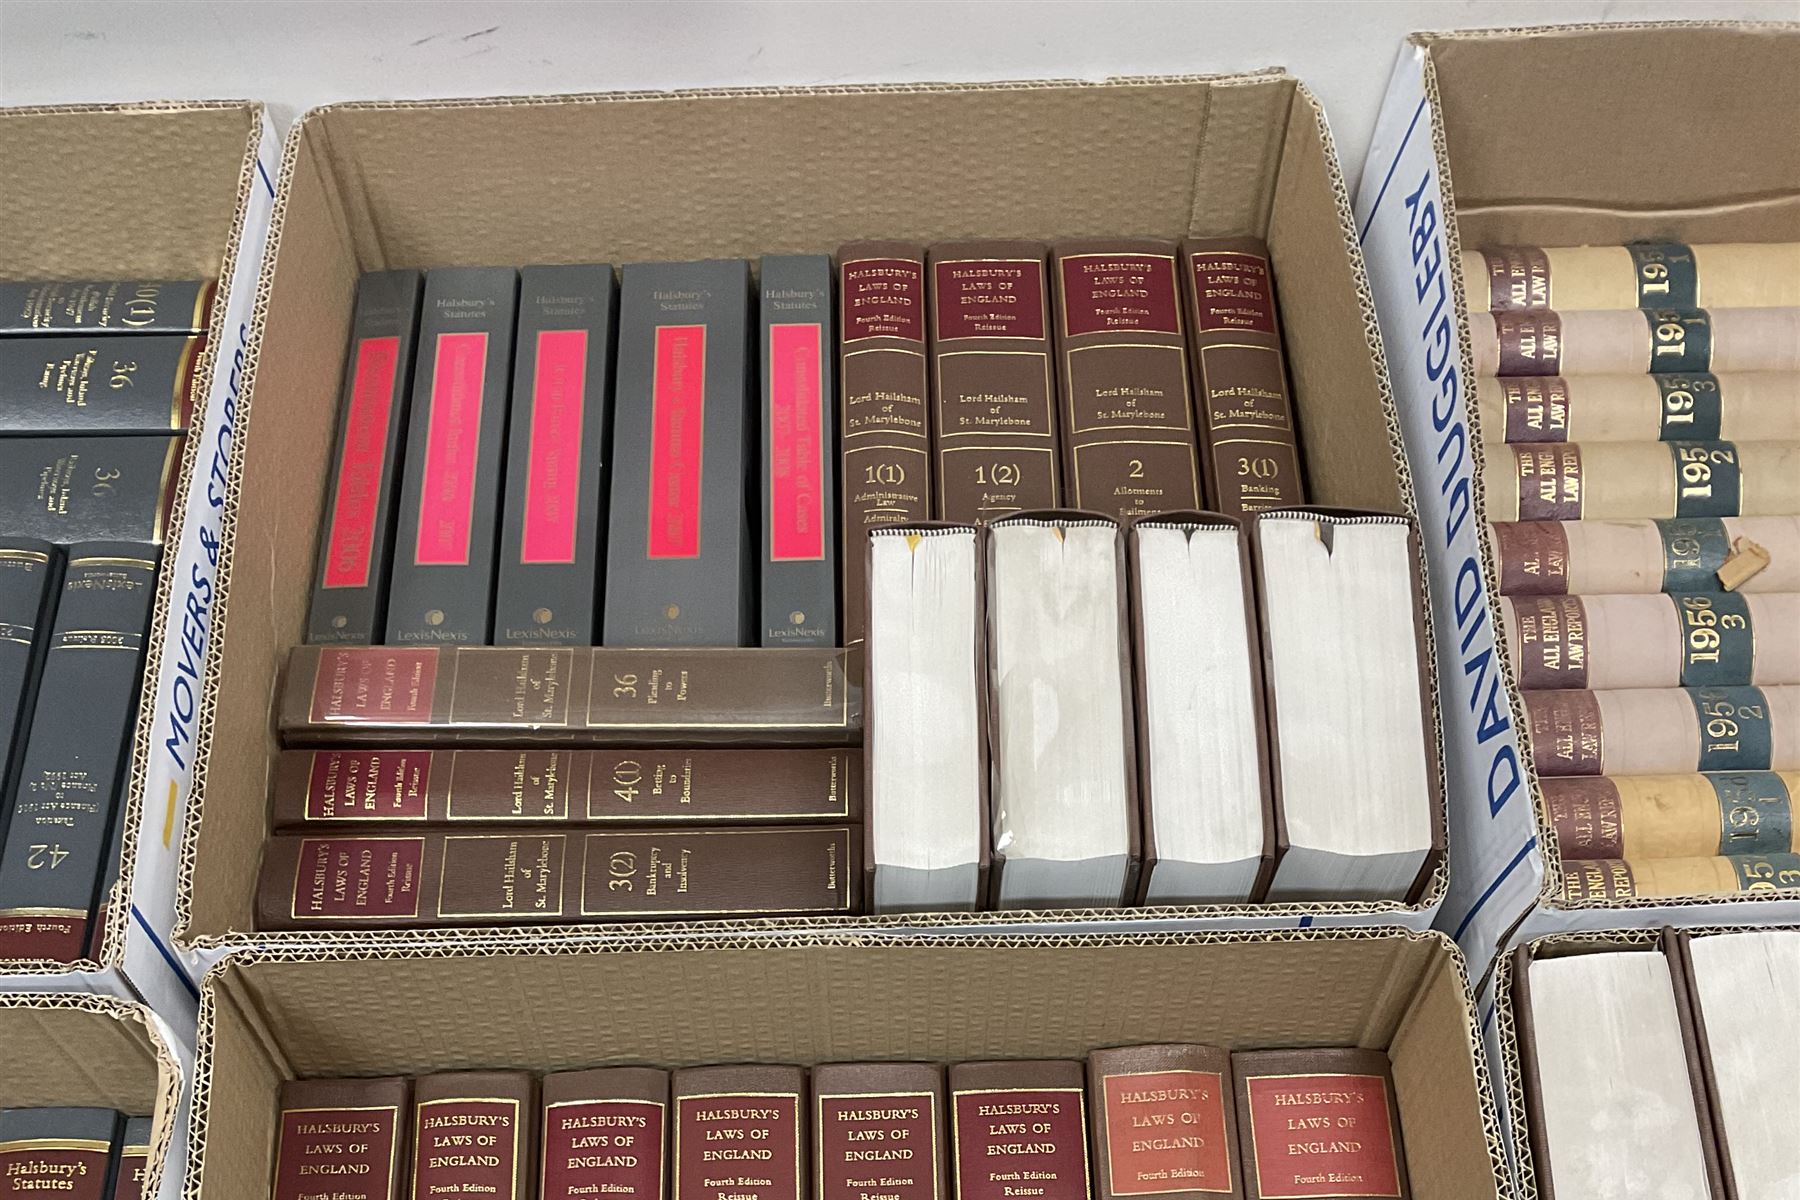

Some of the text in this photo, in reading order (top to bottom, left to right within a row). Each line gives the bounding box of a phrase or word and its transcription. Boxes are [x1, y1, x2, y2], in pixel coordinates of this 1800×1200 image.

[952, 269, 1022, 279] HALSBURY'S
[765, 288, 825, 300] Halsbury's
[961, 282, 1013, 291] LAWS OF
[773, 301, 818, 310] Statutes
[960, 295, 1017, 305] ENGLAND
[1405, 169, 1470, 548] DUGGLEBY
[959, 393, 1028, 403] Lord Hailsham
[989, 405, 1001, 414] of
[959, 416, 1031, 427] St. Marylebone
[1709, 450, 1735, 465] 2
[866, 464, 904, 485] 1(1)
[1129, 459, 1144, 478] 2
[1238, 458, 1277, 478] 3(1)
[981, 492, 1017, 503] Agency
[1113, 486, 1163, 496] Allotments
[1240, 484, 1280, 496] Banking
[1540, 478, 1556, 503] ALL
[1134, 498, 1145, 506] to
[1720, 613, 1746, 630] 3
[397, 628, 468, 641] LexisNexis
[768, 626, 825, 638] LexisNexis
[1521, 615, 1538, 644] THE
[1683, 596, 1720, 664] 1956
[165, 562, 211, 770] MOVERS
[199, 526, 220, 567] &
[1544, 645, 1560, 670] ALL
[614, 675, 637, 697] 36
[1454, 556, 1521, 819] DAVID
[613, 761, 641, 802] 4(1)
[28, 845, 69, 869] 42
[609, 852, 637, 891] 3(2)
[645, 847, 661, 896] Bankruptcy
[661, 862, 672, 879] and
[676, 849, 692, 893] Insolvency
[826, 843, 836, 890] Butterworths
[311, 846, 329, 910] HALSBURY'S
[333, 852, 350, 901] LAWS OF
[355, 849, 372, 906] ENGLAND
[502, 841, 518, 909] Lord Hailsham
[1565, 871, 1582, 900] THE
[1273, 1091, 1366, 1107] HALSBURY'S
[837, 1108, 919, 1121] HALSBURY'S
[978, 1103, 1060, 1116] HALSBURY'S
[424, 1115, 510, 1130] HALSBURY'S
[561, 1116, 647, 1130] HALSBURY'S
[989, 1123, 1051, 1136] LAWS OF
[1286, 1115, 1358, 1132] LAWS OF
[433, 1135, 497, 1148] LAWS OF
[571, 1135, 635, 1149] LAWS OF
[847, 1129, 910, 1141] LAWS OF
[844, 1149, 914, 1162] ENGLAND
[986, 1143, 1056, 1156] ENGLAND
[1286, 1140, 1363, 1156] ENGLAND
[7, 1161, 87, 1177] Halsbury's
[429, 1155, 500, 1169] ENGLAND
[567, 1155, 638, 1169] ENGLAND
[11, 1177, 74, 1191] Statutes
[567, 1183, 635, 1195] Fourth Edition
